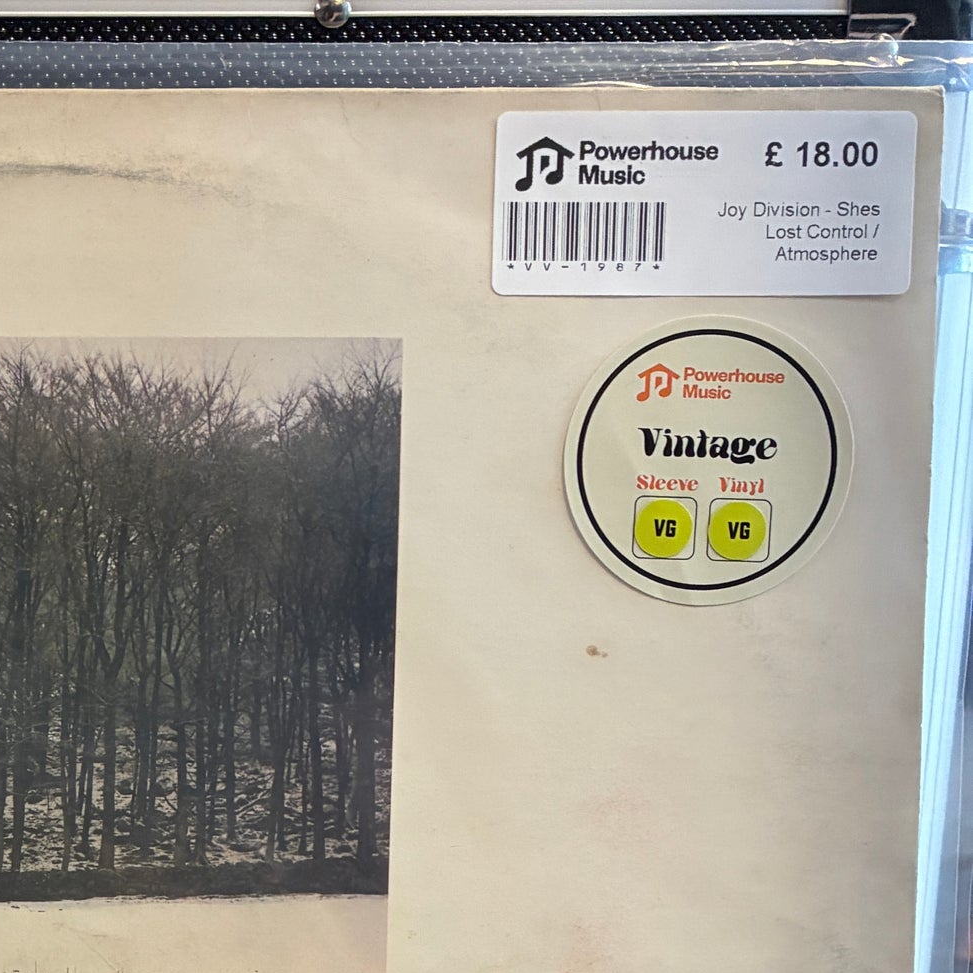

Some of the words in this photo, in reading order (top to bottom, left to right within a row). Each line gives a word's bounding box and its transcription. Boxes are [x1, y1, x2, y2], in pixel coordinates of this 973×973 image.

[579, 140, 719, 161] Powerhouse
[764, 142, 783, 167] £
[796, 141, 879, 168] 18.00
[578, 165, 646, 185] Music
[717, 202, 747, 218] Joy
[753, 201, 821, 218] Division
[837, 201, 880, 217] Shes
[766, 224, 802, 239] Lost
[807, 223, 867, 239] Control
[775, 245, 878, 263] Atmosphere
[683, 367, 785, 384] Powerhouse
[683, 384, 731, 400] Music
[638, 427, 777, 464] Vintage
[636, 474, 698, 491] Sleeve
[718, 476, 765, 496] Vinyl
[654, 519, 677, 538] VG
[727, 521, 751, 540] VG
